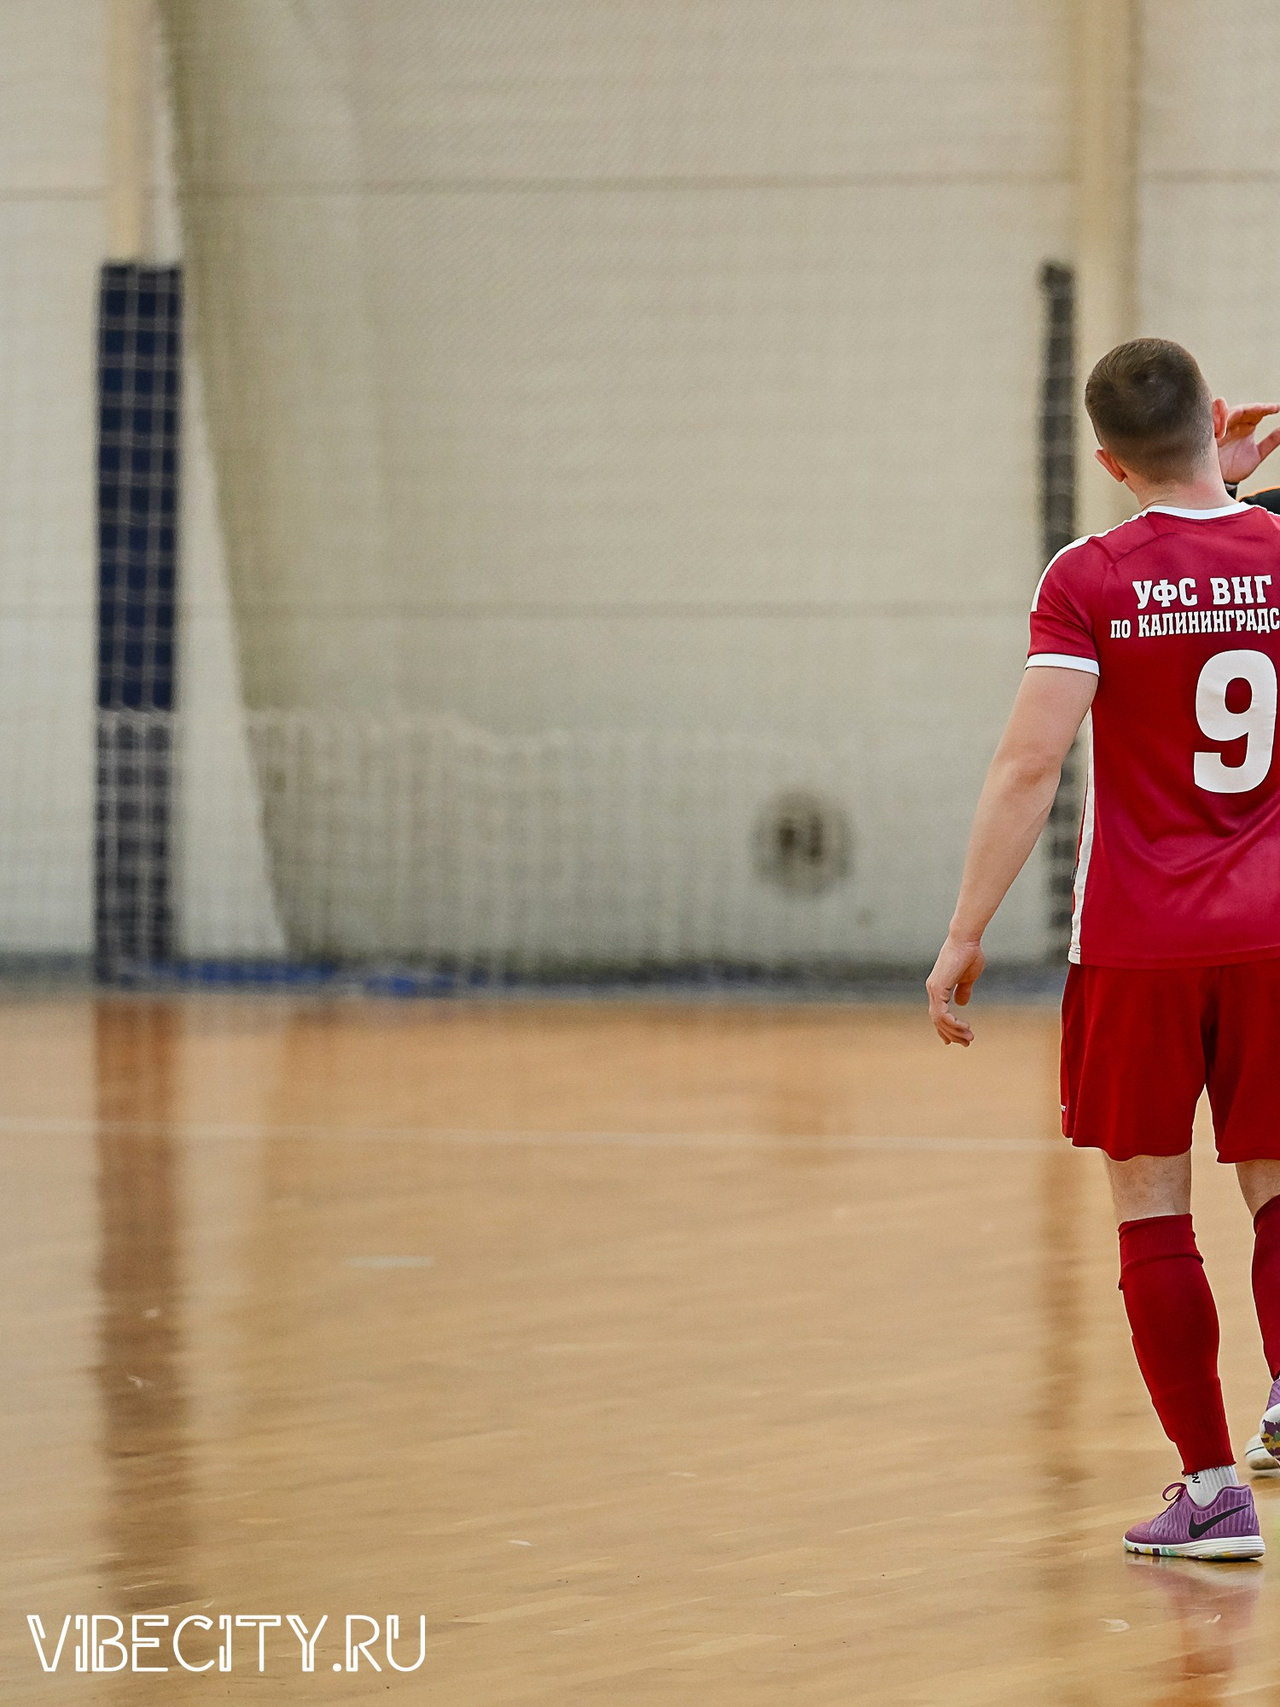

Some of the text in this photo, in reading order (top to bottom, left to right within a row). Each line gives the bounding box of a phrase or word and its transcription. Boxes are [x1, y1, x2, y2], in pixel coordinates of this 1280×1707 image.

[1132, 578, 1198, 609] УФС
[1210, 574, 1272, 605] ВНГ
[1193, 649, 1278, 793] 9
